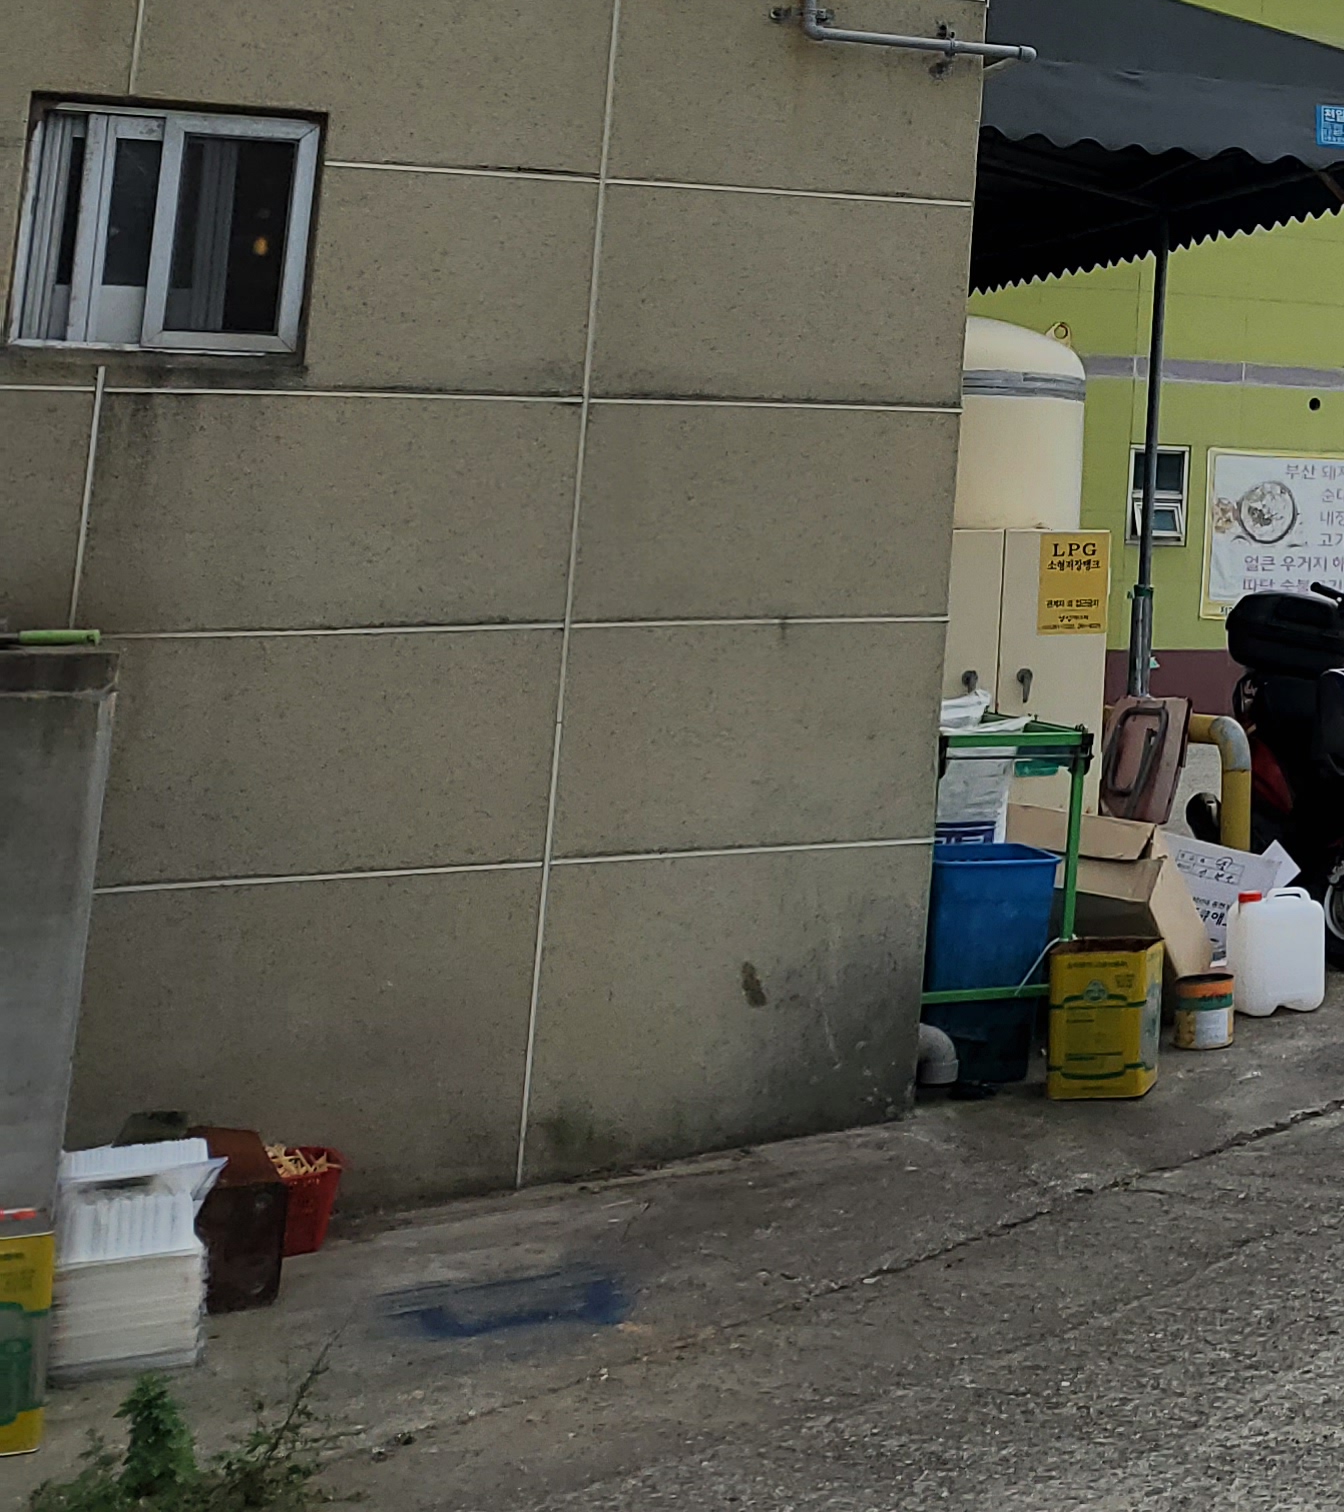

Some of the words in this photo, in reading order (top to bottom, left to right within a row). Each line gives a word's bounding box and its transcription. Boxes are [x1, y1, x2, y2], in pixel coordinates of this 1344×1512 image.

[1285, 464, 1316, 480] 부산
[1052, 542, 1097, 557] LPG
[1244, 555, 1276, 572] 얼큰
[1280, 556, 1328, 573] 우거지
